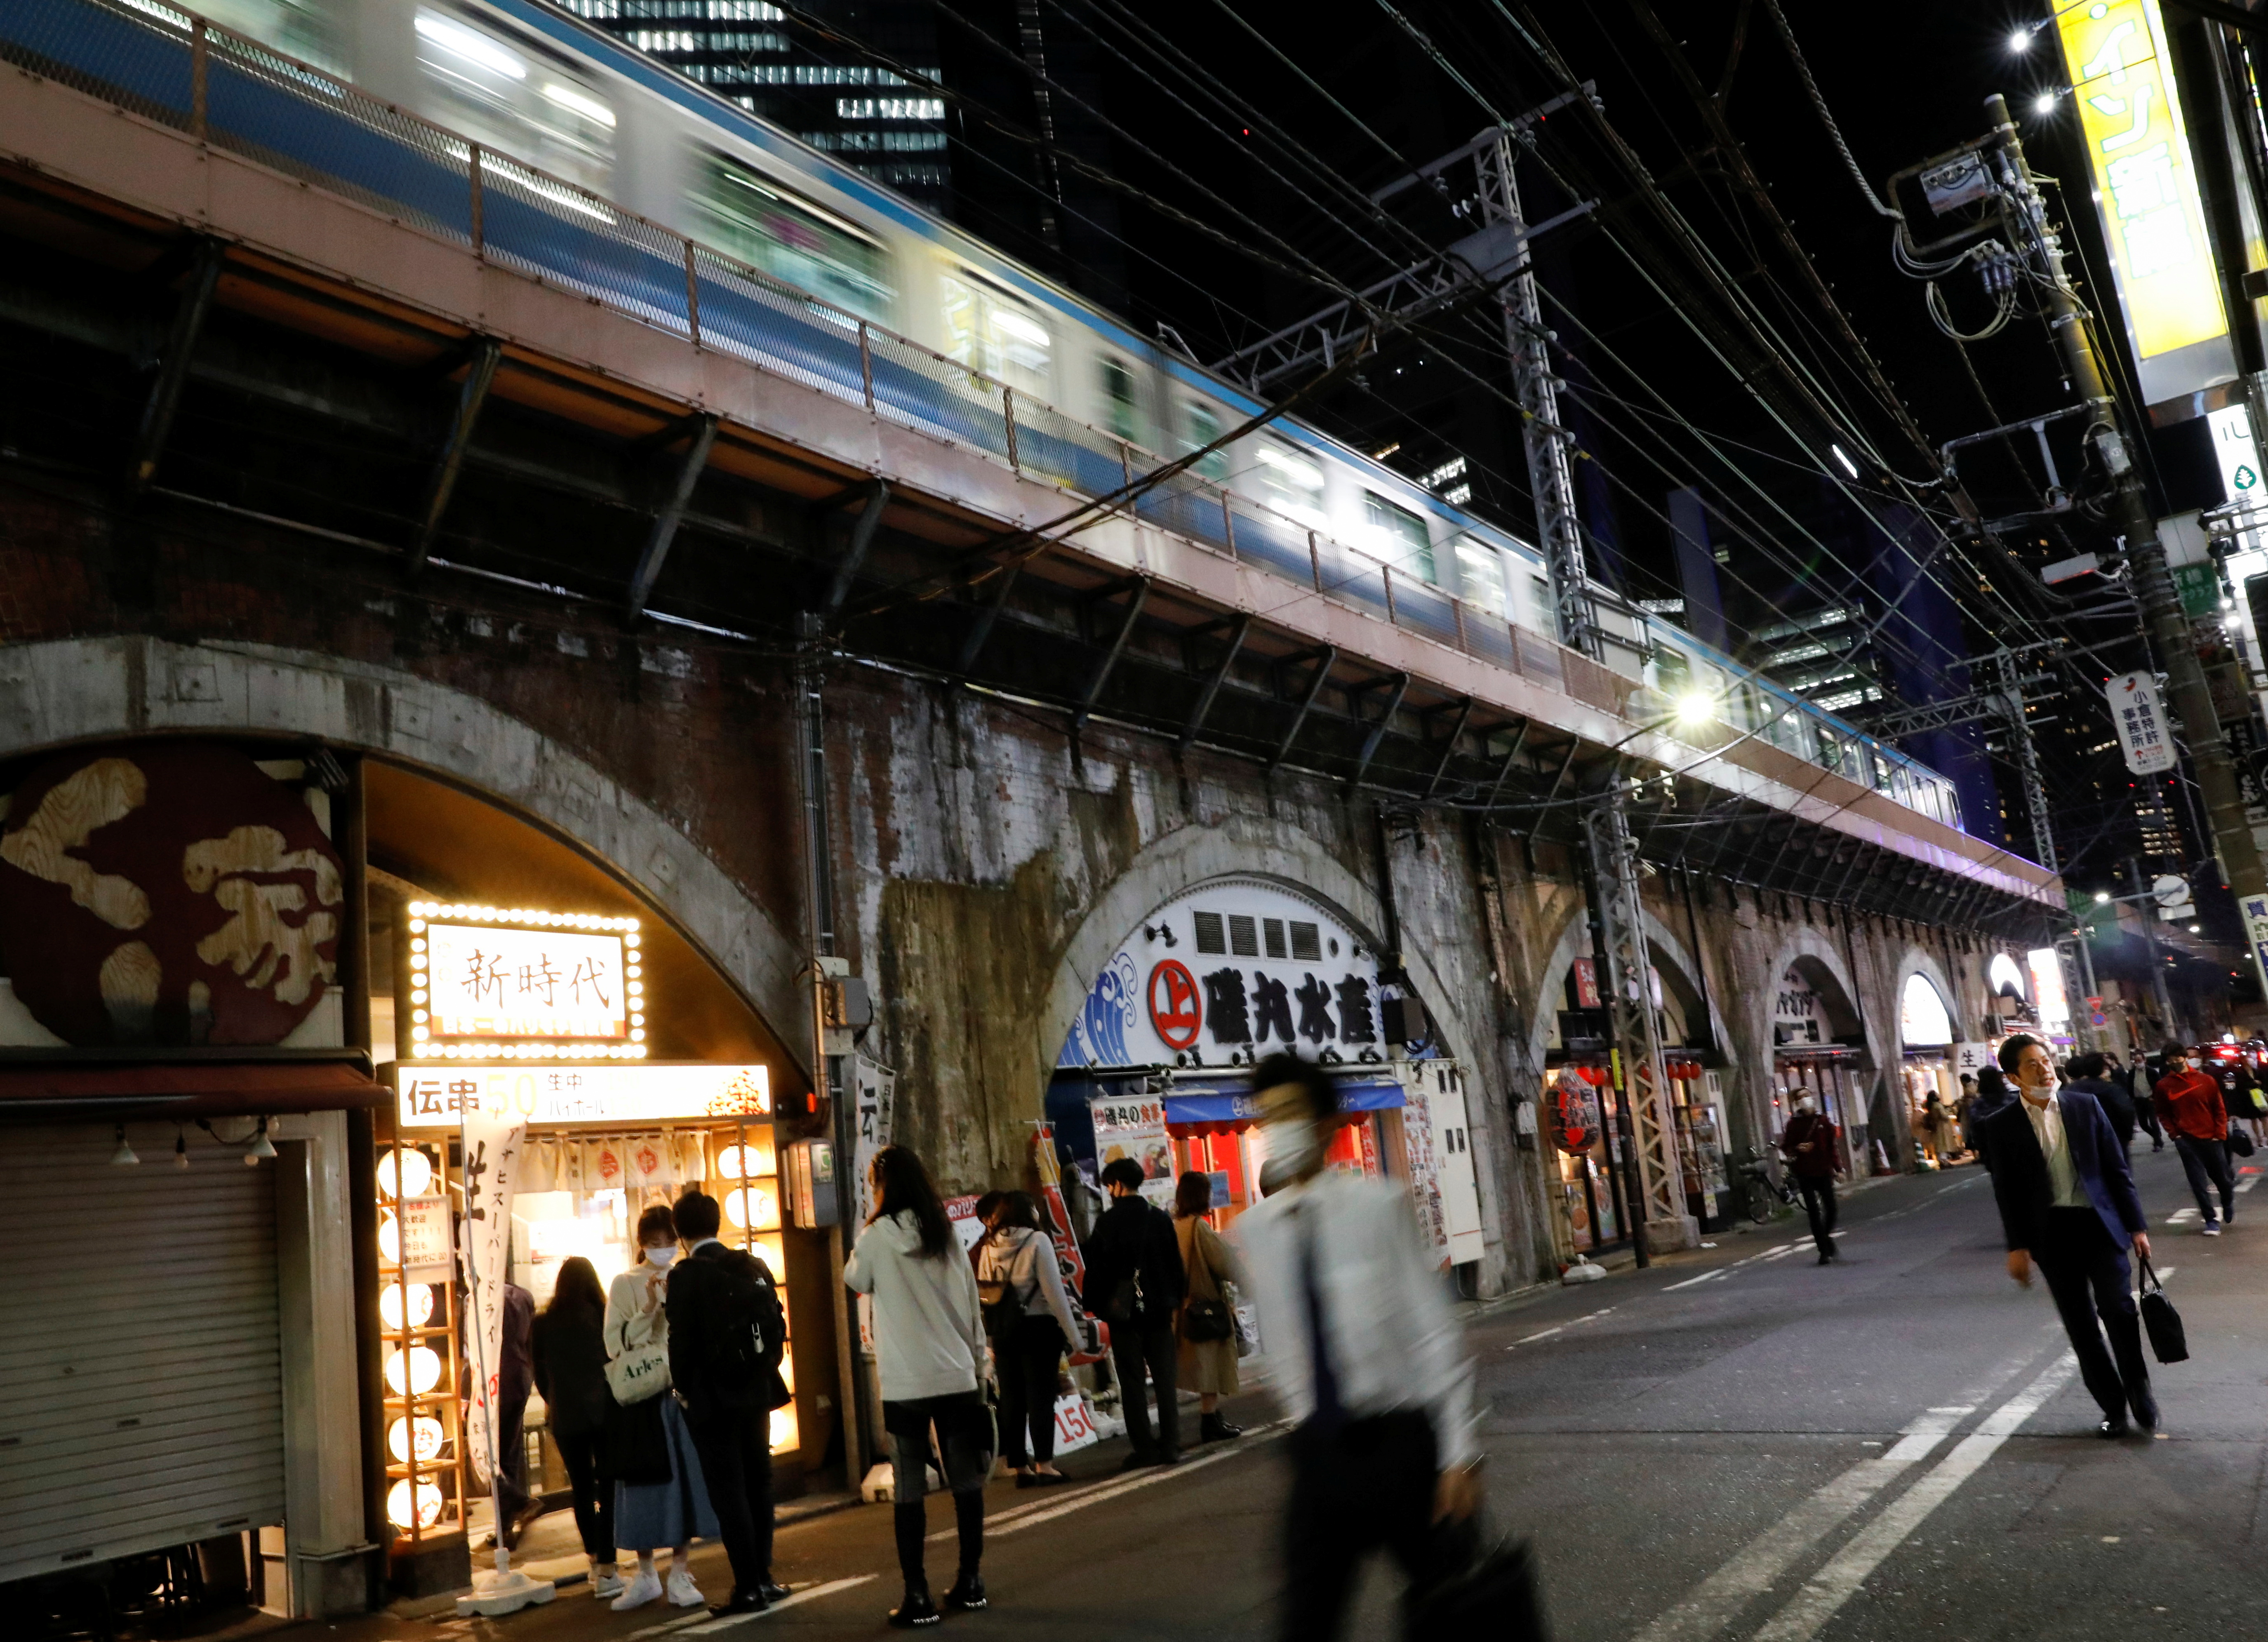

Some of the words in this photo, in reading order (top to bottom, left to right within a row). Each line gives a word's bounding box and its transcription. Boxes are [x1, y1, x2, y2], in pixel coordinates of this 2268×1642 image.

[2121, 708, 2144, 748] 事務所
[2133, 691, 2159, 744] 小倉特許
[460, 948, 609, 1010] 新時代
[1202, 967, 1376, 1044] 磯丸水産
[548, 1073, 582, 1091] 生中
[1960, 1050, 1977, 1067] 生
[408, 1079, 479, 1116] 伝串
[485, 1073, 537, 1115] 50
[486, 1127, 520, 1343] アサヒスーパードライ
